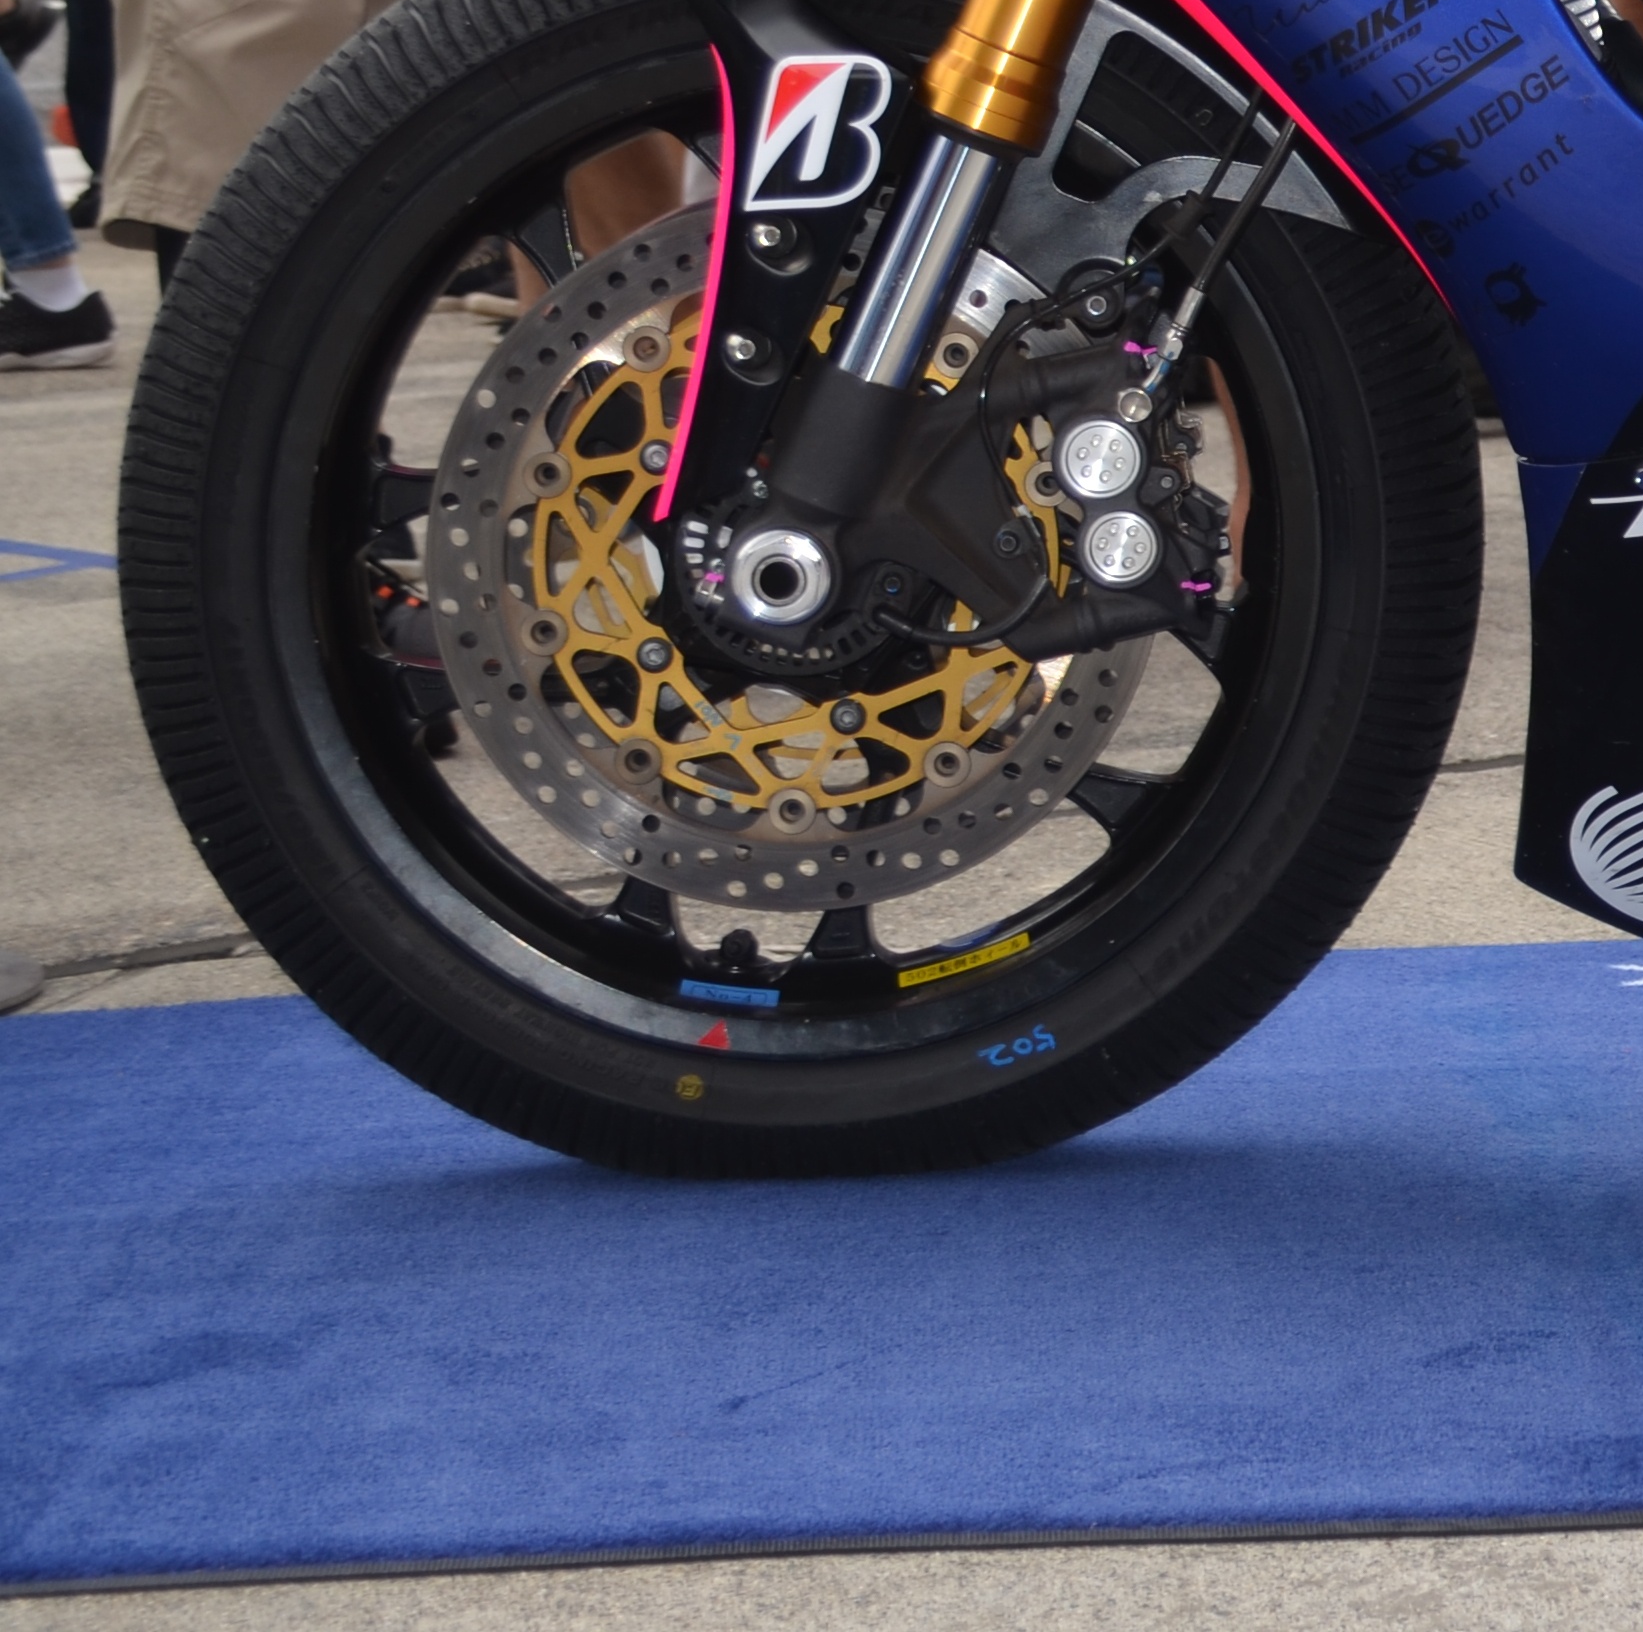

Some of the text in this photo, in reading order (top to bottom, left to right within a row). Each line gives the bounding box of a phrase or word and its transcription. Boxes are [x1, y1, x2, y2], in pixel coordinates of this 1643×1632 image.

[1338, 22, 1424, 79] Racing
[1391, 8, 1515, 103] DESIGN
[977, 1023, 1057, 1066] 502
